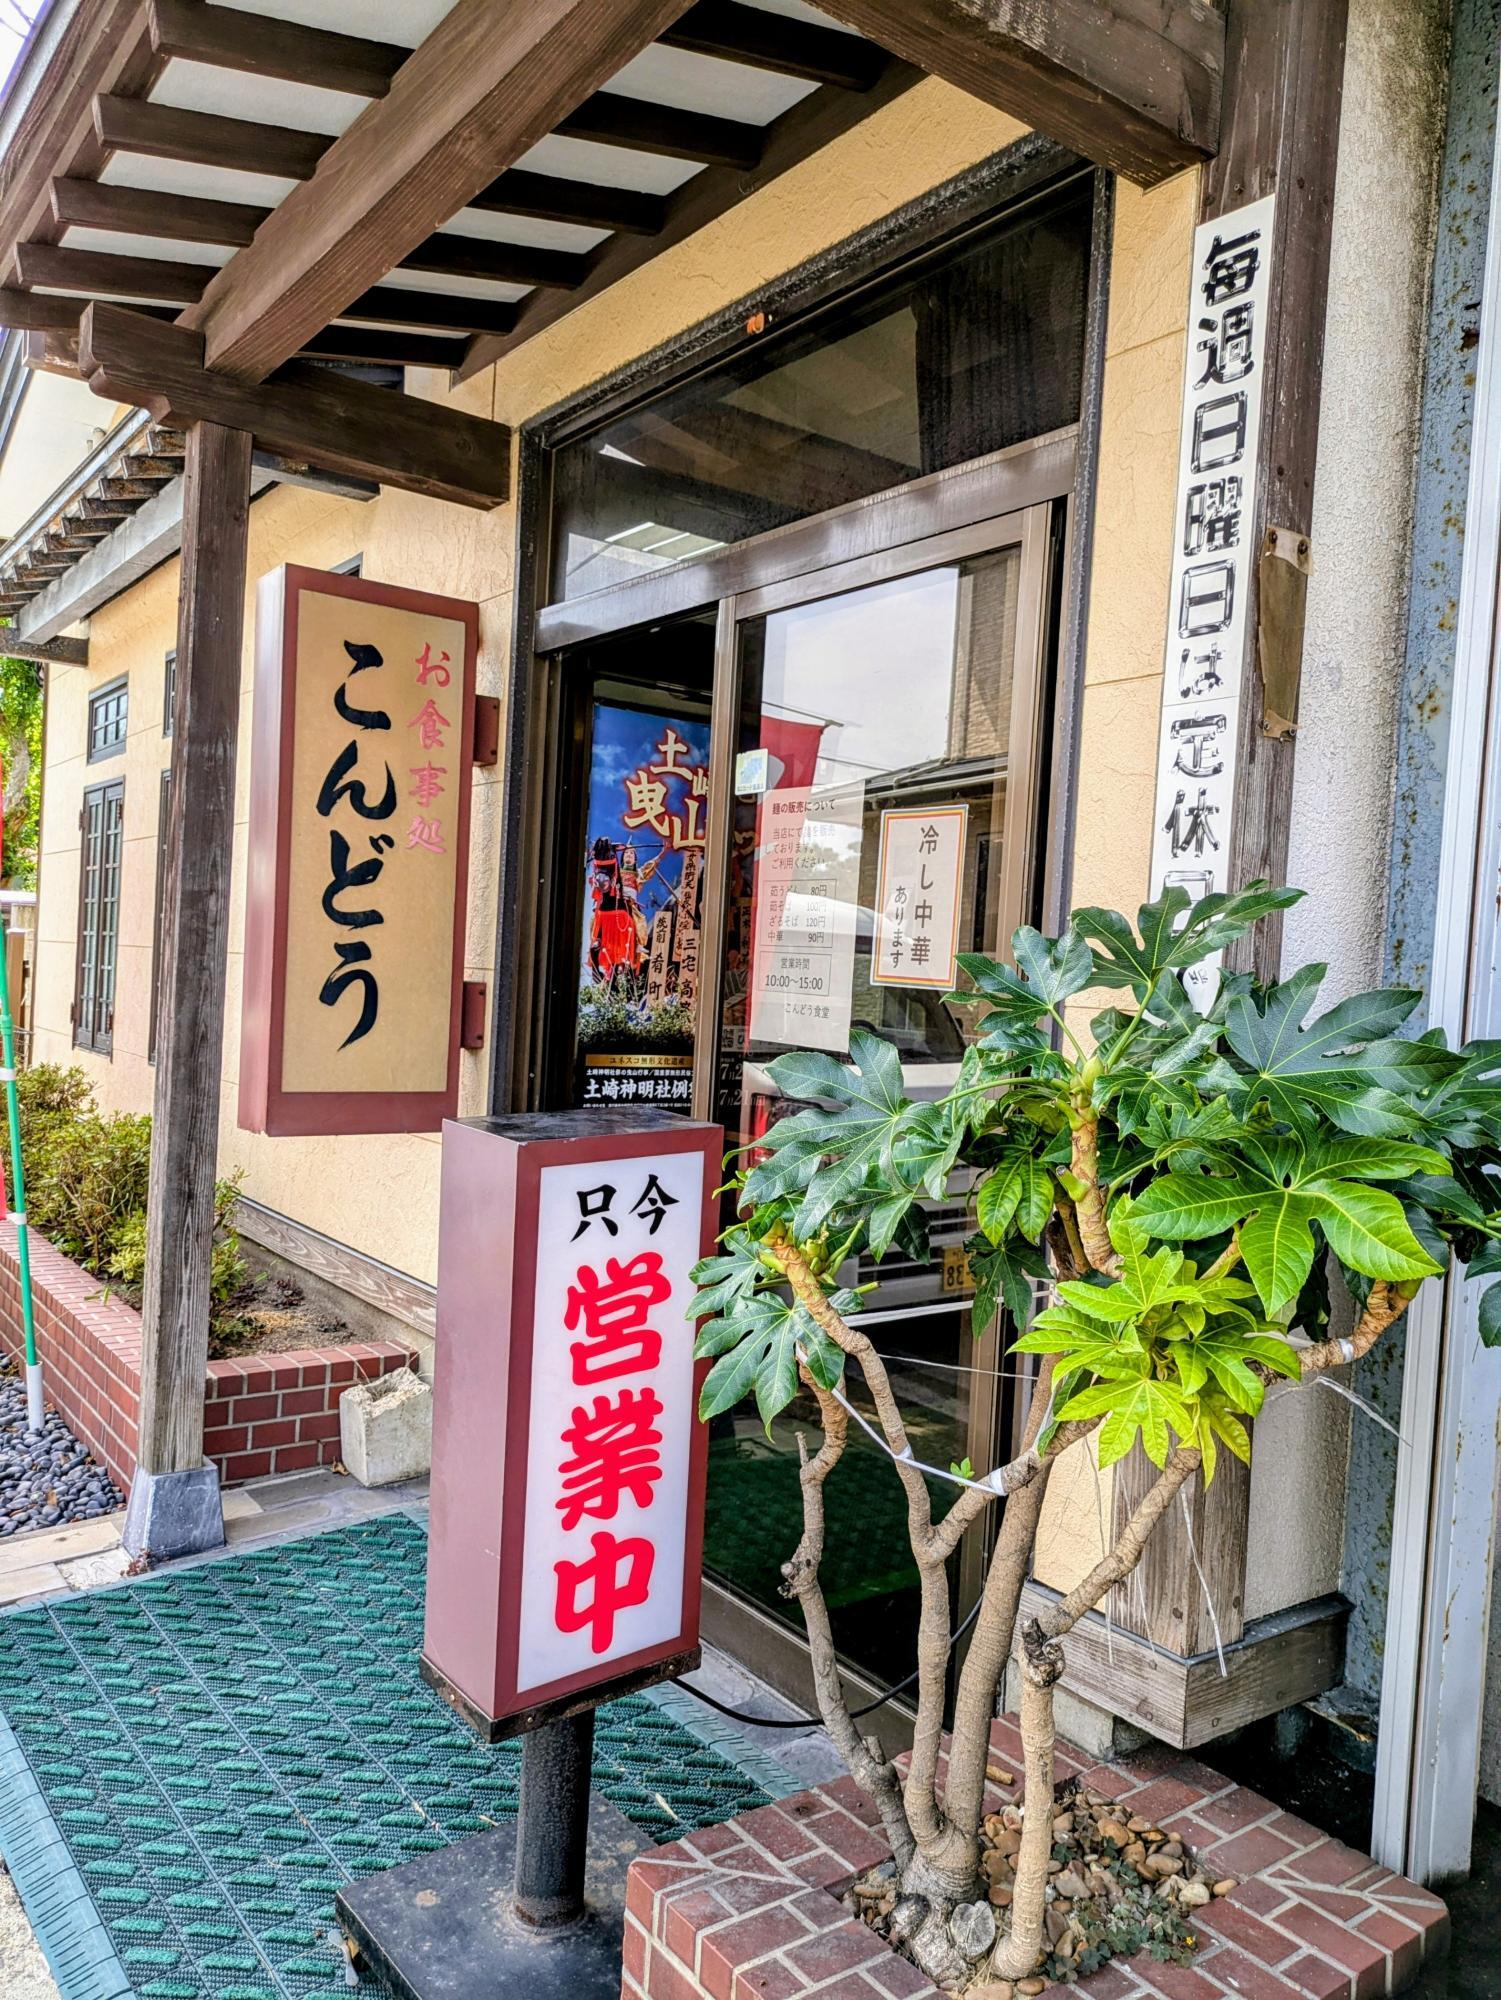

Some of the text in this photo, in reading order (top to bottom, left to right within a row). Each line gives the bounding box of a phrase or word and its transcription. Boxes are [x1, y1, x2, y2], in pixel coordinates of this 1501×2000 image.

[405, 642, 452, 855] お食事処
[316, 639, 398, 1052] こんどう
[810, 885, 827, 897] 80円
[910, 824, 940, 966] 冷し中華
[768, 931, 825, 943] 中華 90円
[806, 916, 826, 928] 120円
[890, 885, 908, 969] あります
[780, 957, 810, 970] 営業時間
[785, 1002, 830, 1019] こんどう食堂
[554, 1251, 672, 1655] 営業中
